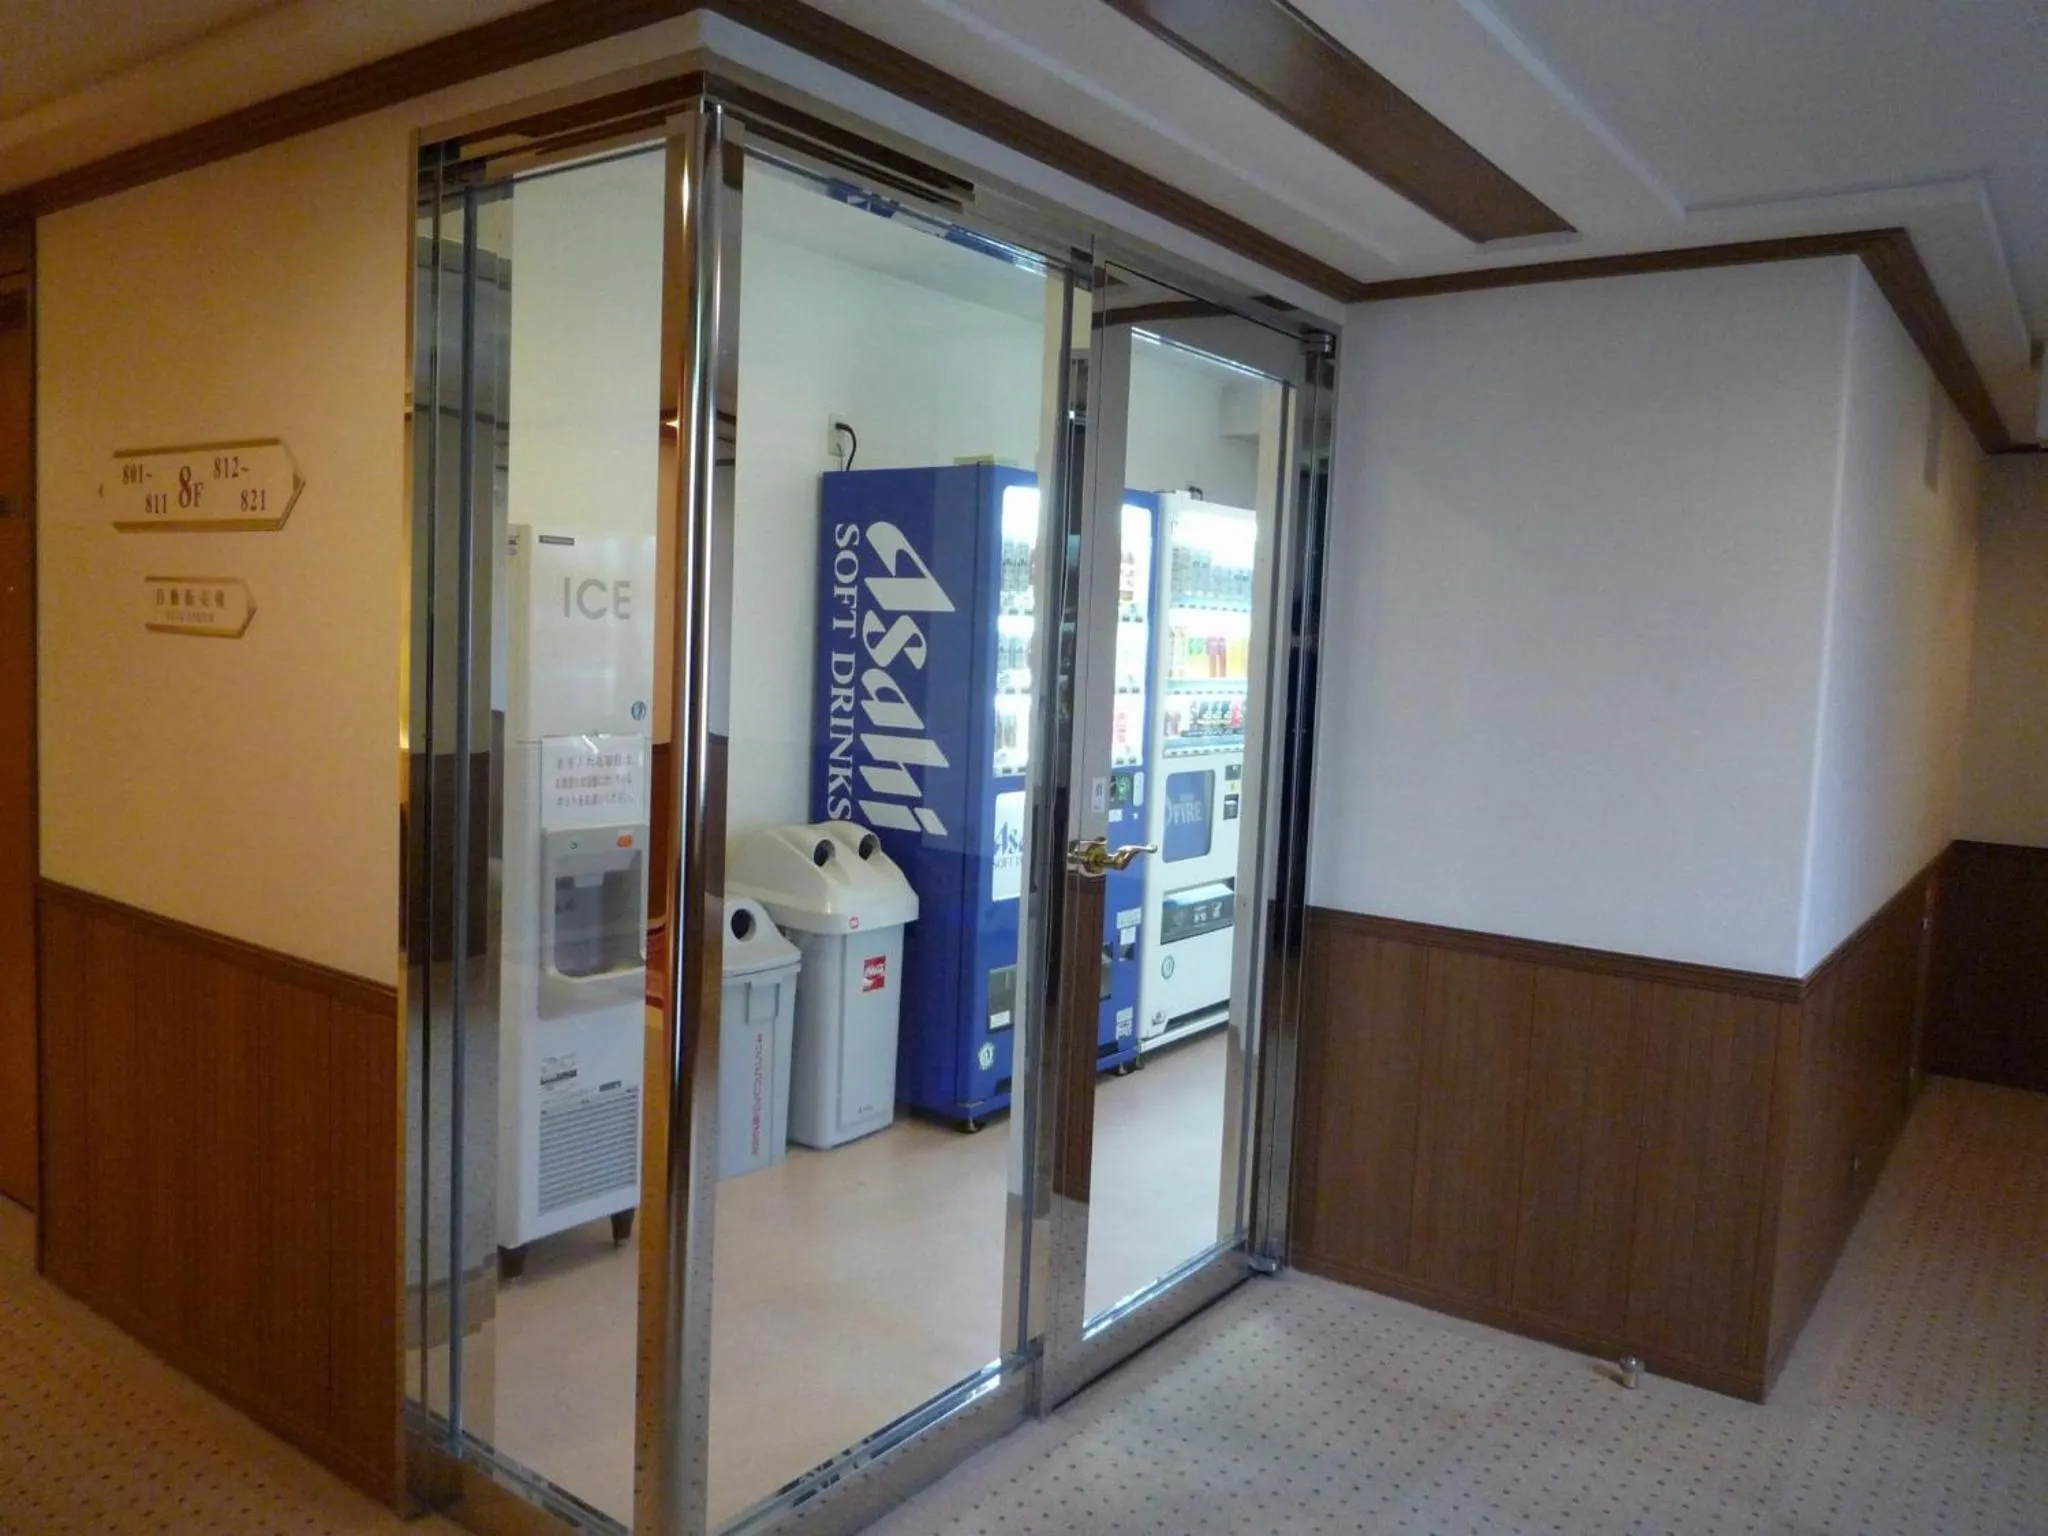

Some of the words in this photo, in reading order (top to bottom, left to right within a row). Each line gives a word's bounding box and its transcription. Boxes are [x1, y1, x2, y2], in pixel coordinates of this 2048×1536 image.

[145, 493, 168, 514] 811
[240, 489, 266, 512] 821
[563, 576, 631, 620] ICE
[832, 523, 860, 639] SOFT
[859, 521, 955, 836] Asahi
[827, 651, 856, 820] DRINKS
